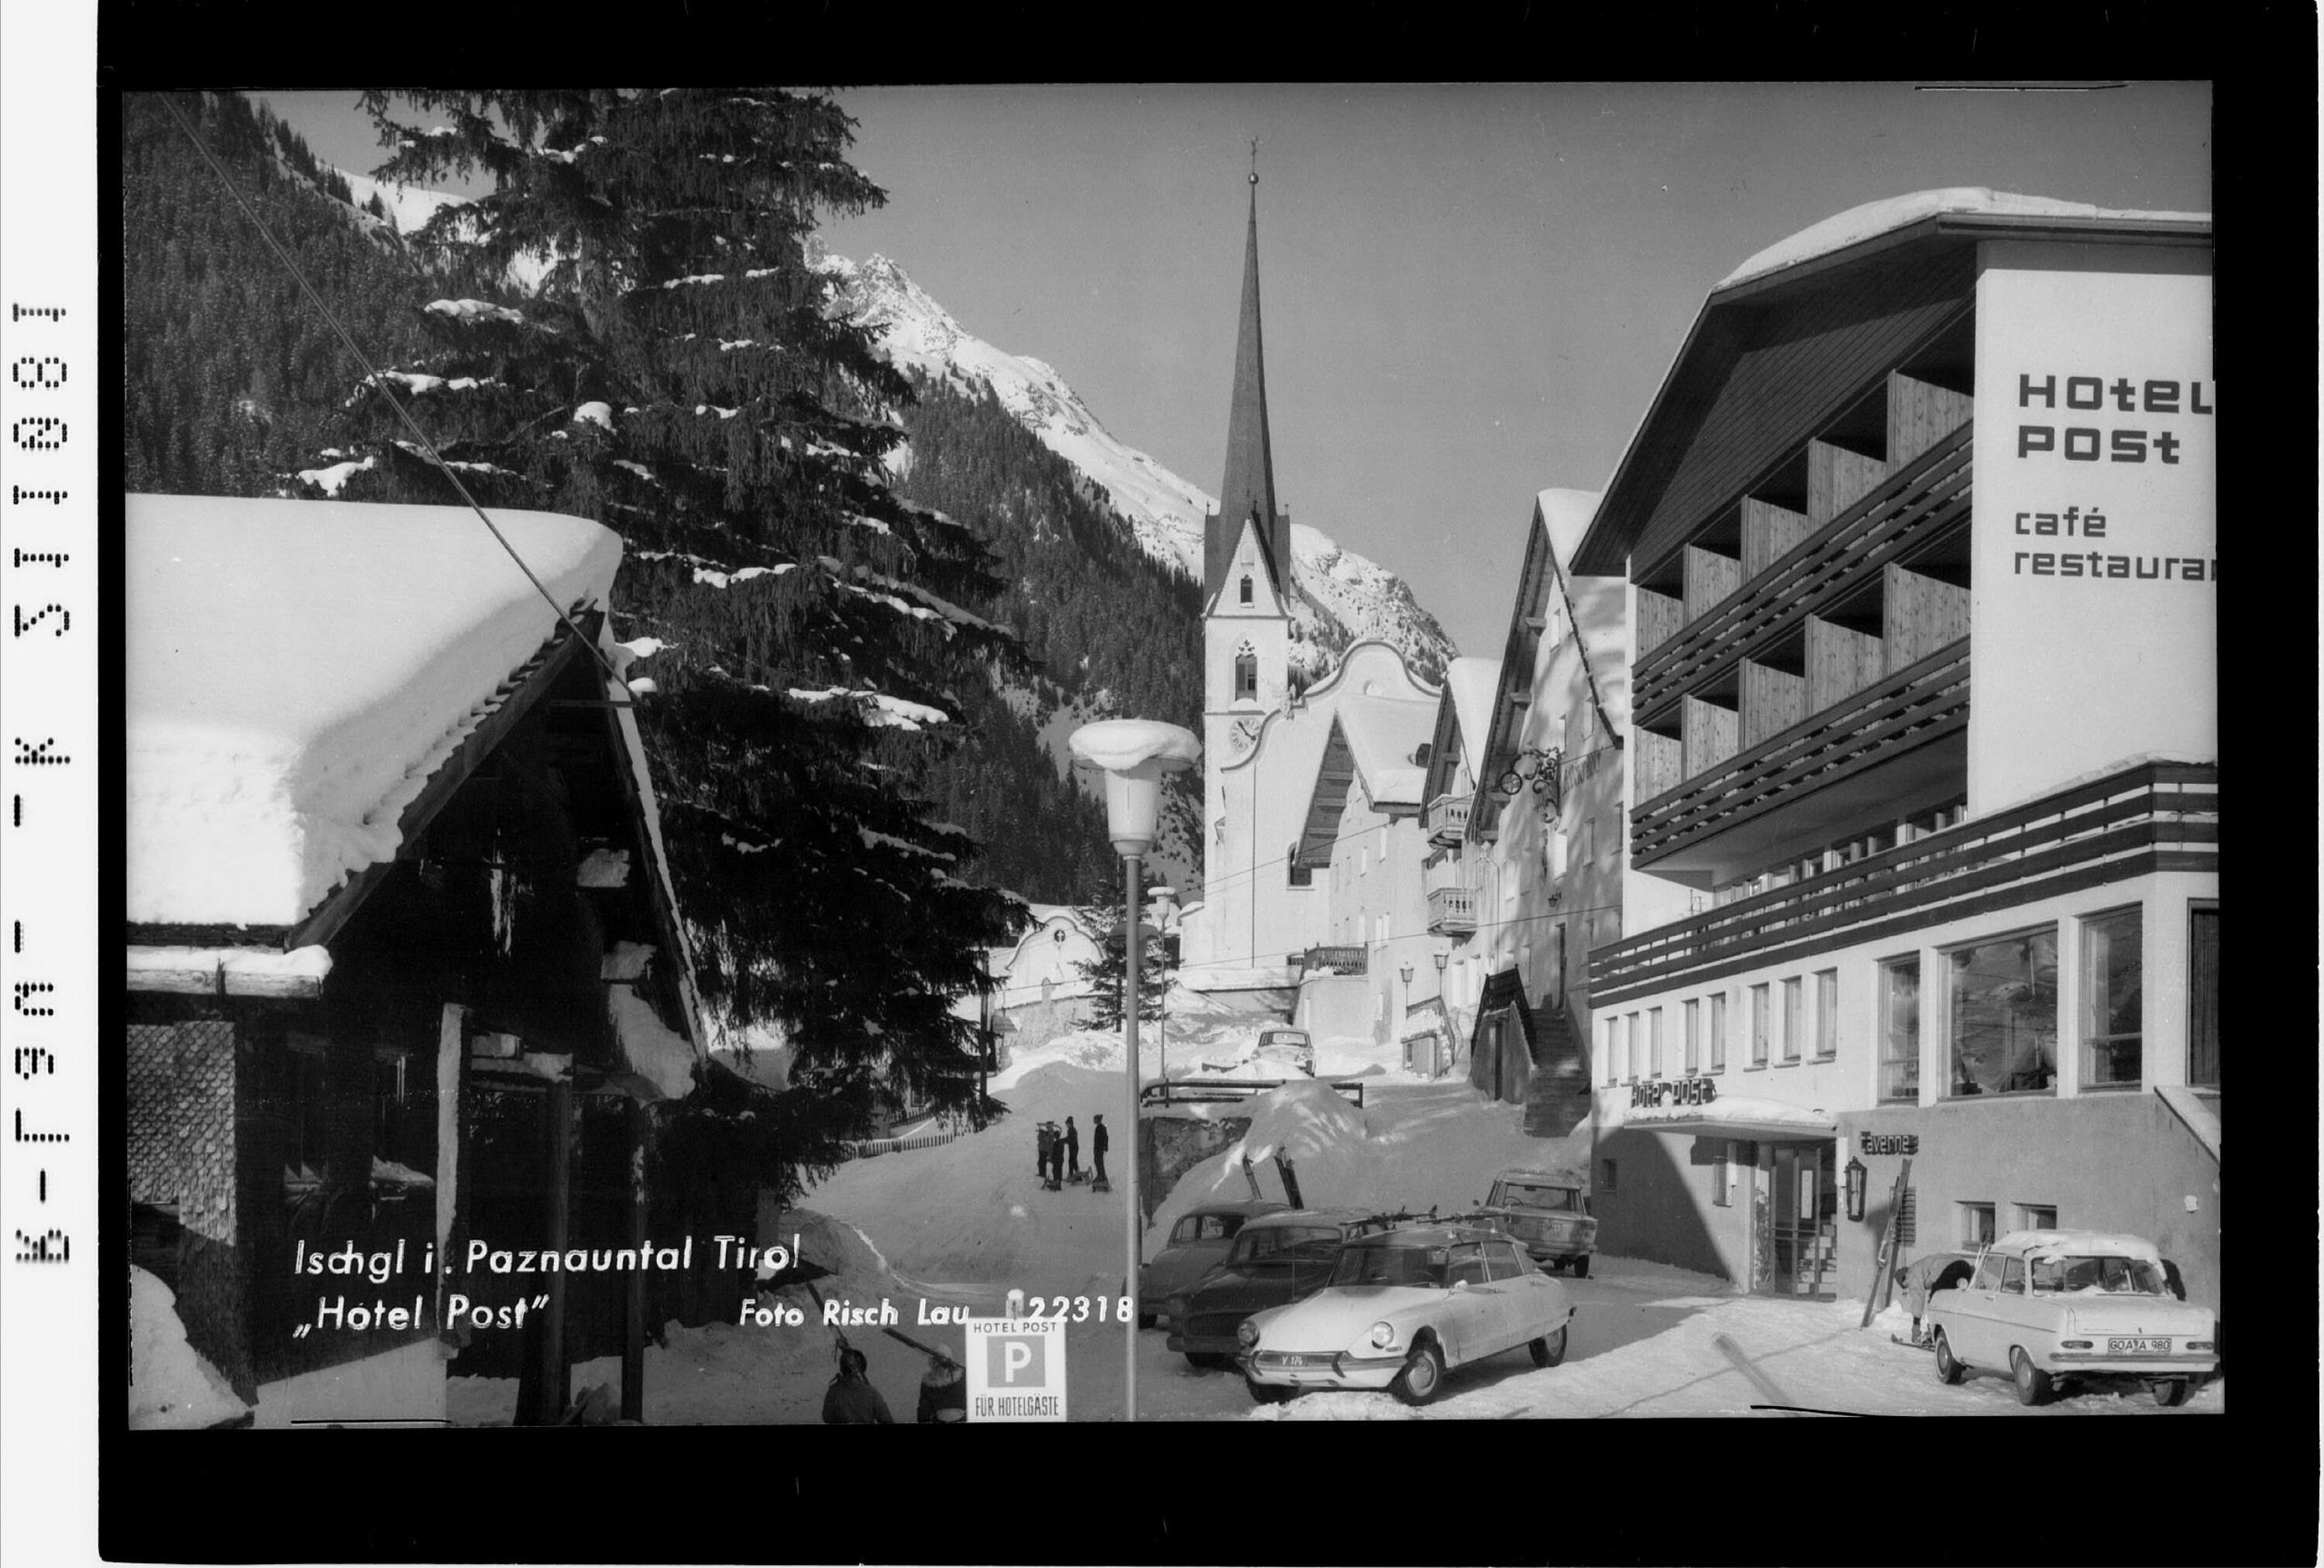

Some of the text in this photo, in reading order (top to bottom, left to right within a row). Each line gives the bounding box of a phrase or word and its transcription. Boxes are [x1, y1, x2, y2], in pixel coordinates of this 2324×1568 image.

[2015, 506, 2106, 538] café
[2014, 551, 2216, 581] restaura
[1860, 1131, 1913, 1154] taverne
[973, 1321, 1057, 1333] HOTEL POST
[1004, 1341, 1032, 1383] P
[975, 1393, 1060, 1418] FÜR HOTELGÄSTE
